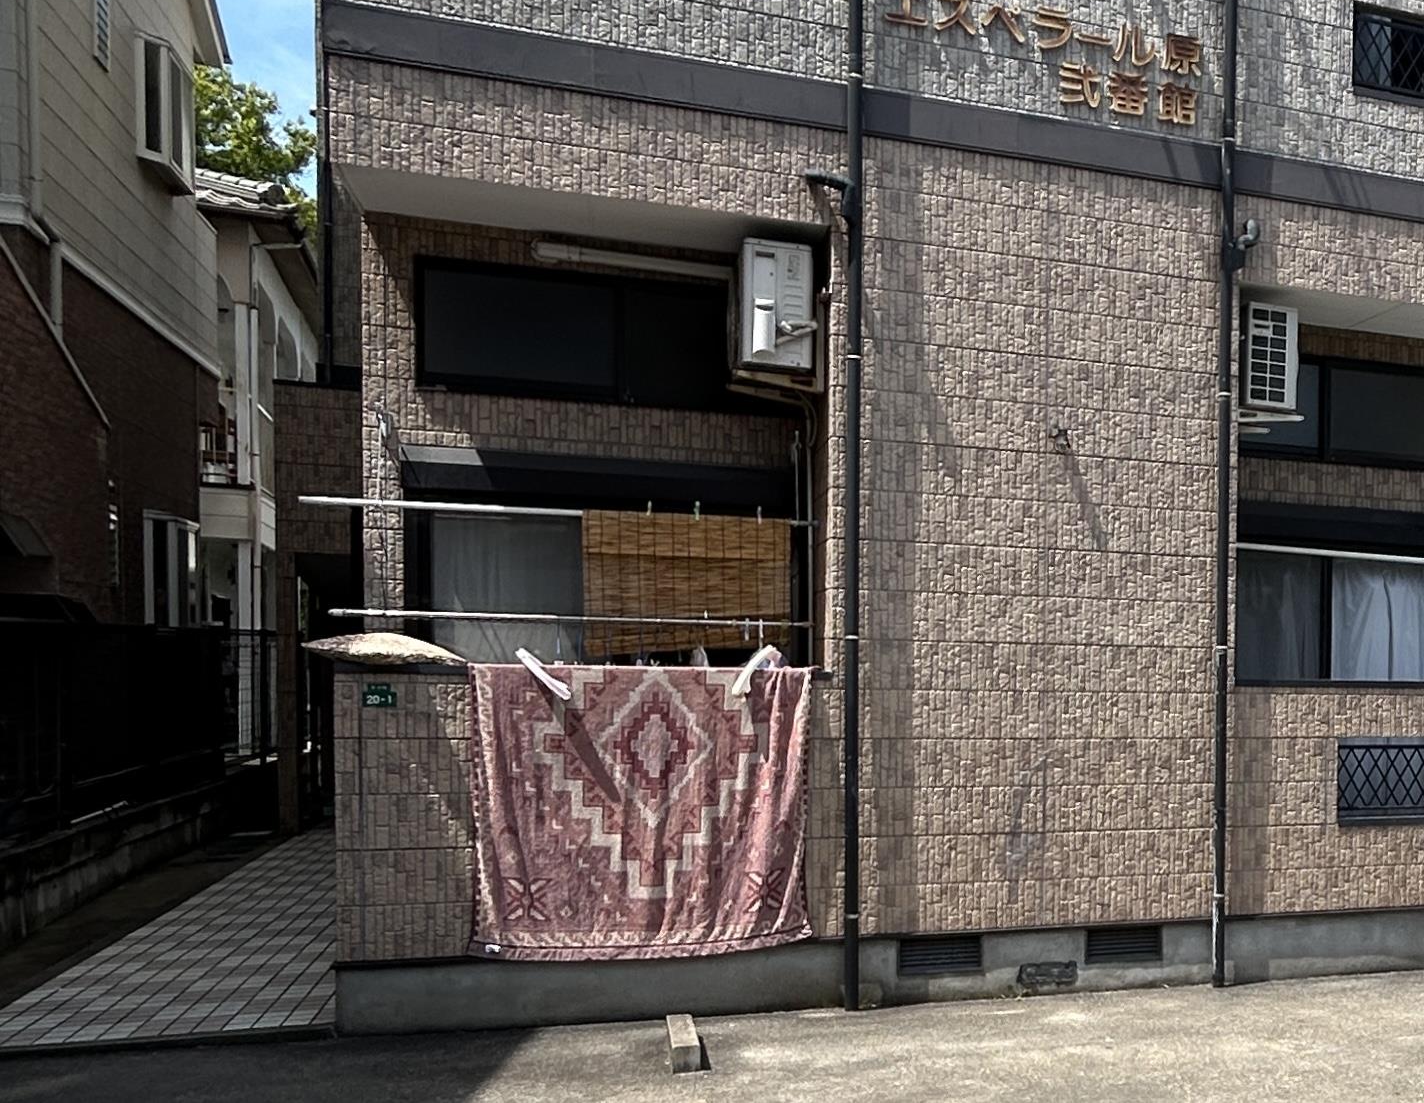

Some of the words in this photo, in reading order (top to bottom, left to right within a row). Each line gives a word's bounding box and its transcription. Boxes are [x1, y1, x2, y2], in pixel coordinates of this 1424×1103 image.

[1059, 61, 1196, 125] 弐番館
[366, 694, 392, 705] 20-1
